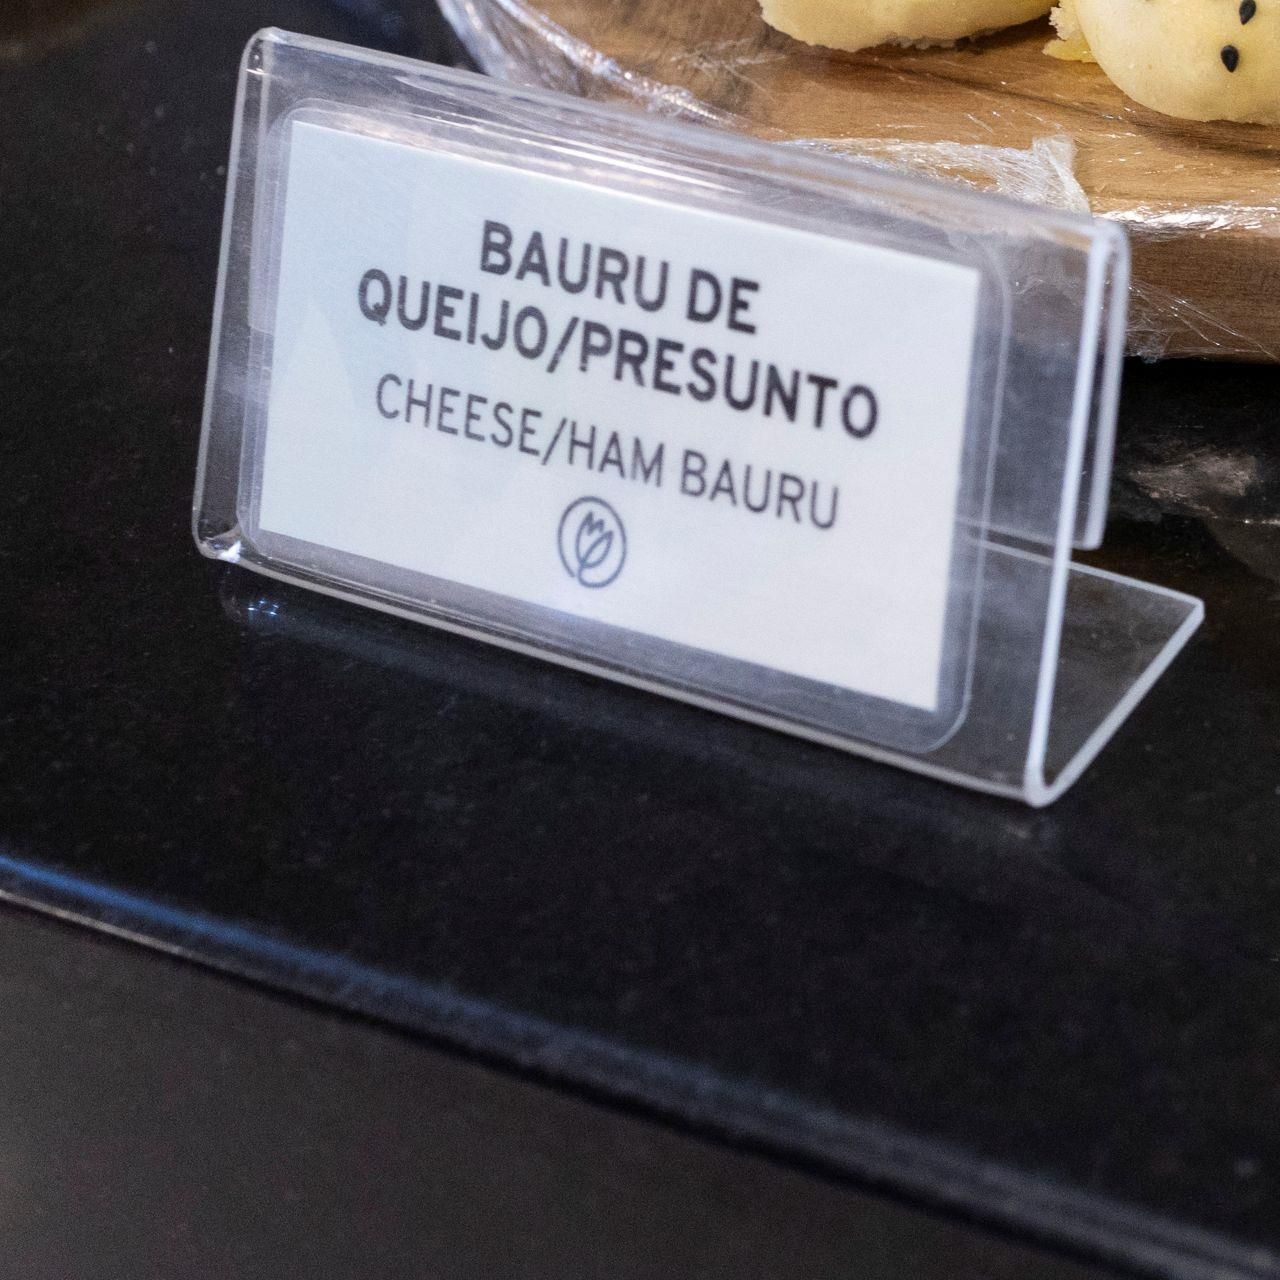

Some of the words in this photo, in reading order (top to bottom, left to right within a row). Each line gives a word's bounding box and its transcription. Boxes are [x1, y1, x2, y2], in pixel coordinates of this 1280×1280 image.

[357, 267, 879, 441] QUEIJO/PRESUNTO
[479, 219, 671, 314] BAURU
[685, 267, 760, 335] DE
[375, 372, 665, 489] CHEESE/HAM
[679, 448, 840, 531] BAURU
